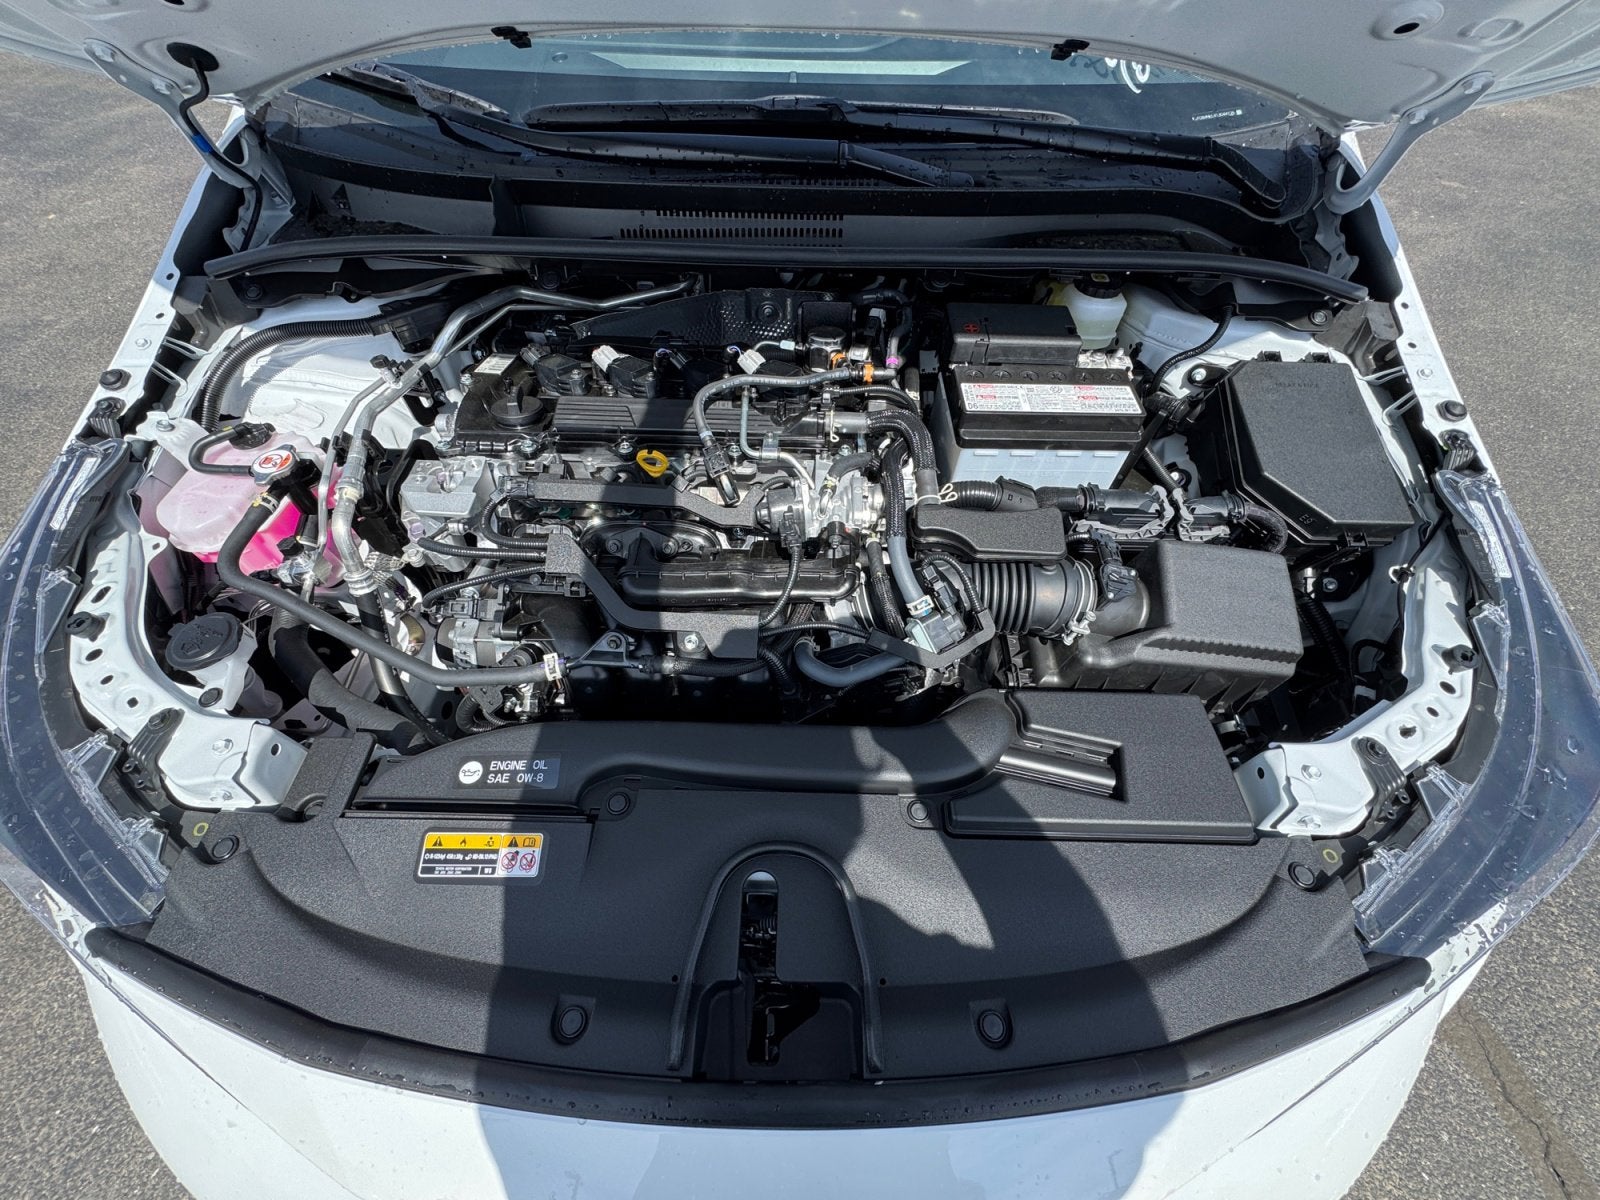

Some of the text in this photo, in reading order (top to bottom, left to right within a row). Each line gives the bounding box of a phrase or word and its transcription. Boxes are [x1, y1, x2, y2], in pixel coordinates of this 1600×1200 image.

[489, 760, 548, 771] ENGINE OIL
[487, 773, 510, 784] SAE
